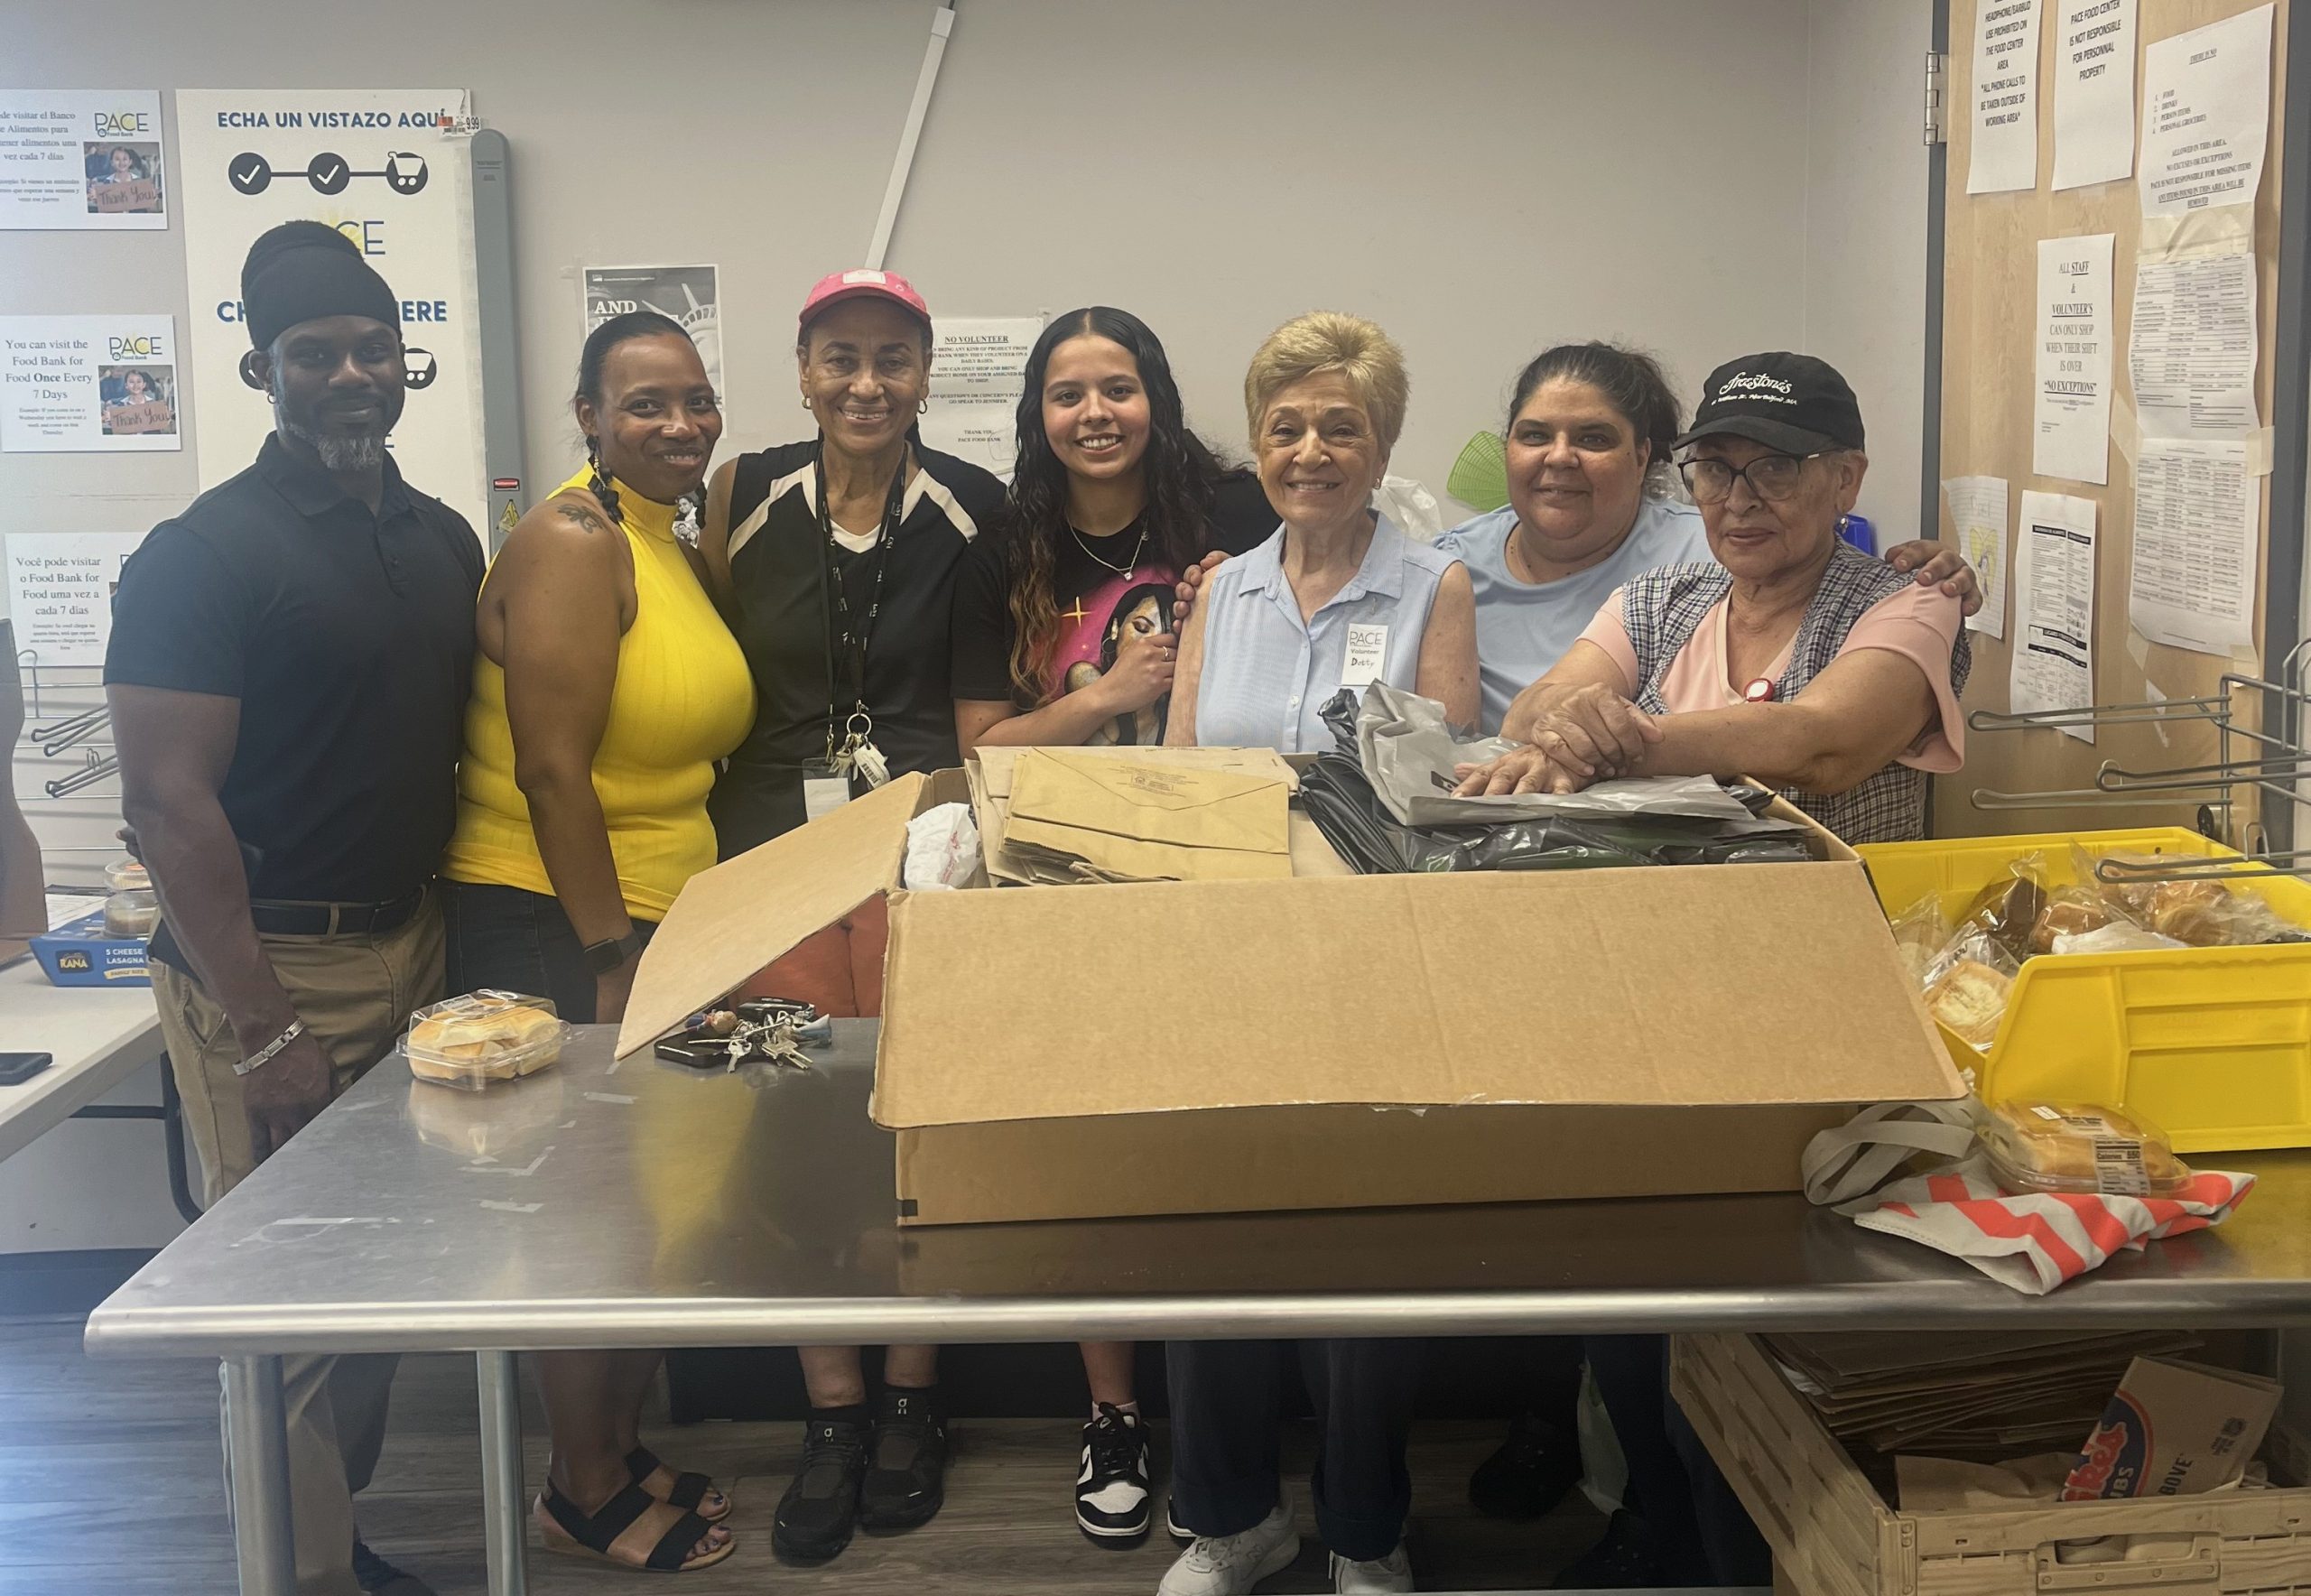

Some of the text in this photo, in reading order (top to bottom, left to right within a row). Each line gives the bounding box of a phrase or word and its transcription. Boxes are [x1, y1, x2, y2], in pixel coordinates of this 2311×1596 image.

[2084, 5, 2099, 20] FOOD
[14, 111, 38, 119] visitar
[41, 111, 47, 119] el
[51, 111, 76, 120] Banco
[218, 112, 270, 128] ECHA
[275, 112, 303, 128] UN
[309, 112, 392, 128] VISTAZO
[94, 112, 149, 133] PACE
[7, 125, 49, 133] Alimentos
[51, 126, 69, 135] para
[22, 138, 60, 147] alimentos
[20, 152, 39, 161] cada
[41, 152, 45, 161] 7
[2060, 261, 2090, 274] ALL STAFF
[594, 300, 637, 314] AND
[5, 339, 88, 349] You can visit the
[109, 337, 162, 355] PACE
[945, 336, 957, 344] NO
[13, 356, 84, 367] Food Bank for
[2067, 360, 2083, 372] OVER
[6, 373, 92, 385] Food Once Every
[33, 389, 69, 402] 7 Days
[16, 556, 102, 569] Você pode visitar
[30, 573, 54, 583] Food
[58, 572, 82, 583] Bank
[86, 572, 100, 582] for
[23, 589, 48, 599] Food
[35, 606, 89, 615] cada 7 dias
[1350, 631, 1383, 645] PACE
[60, 958, 88, 969] RANA
[2158, 1457, 2194, 1496] BOVE
